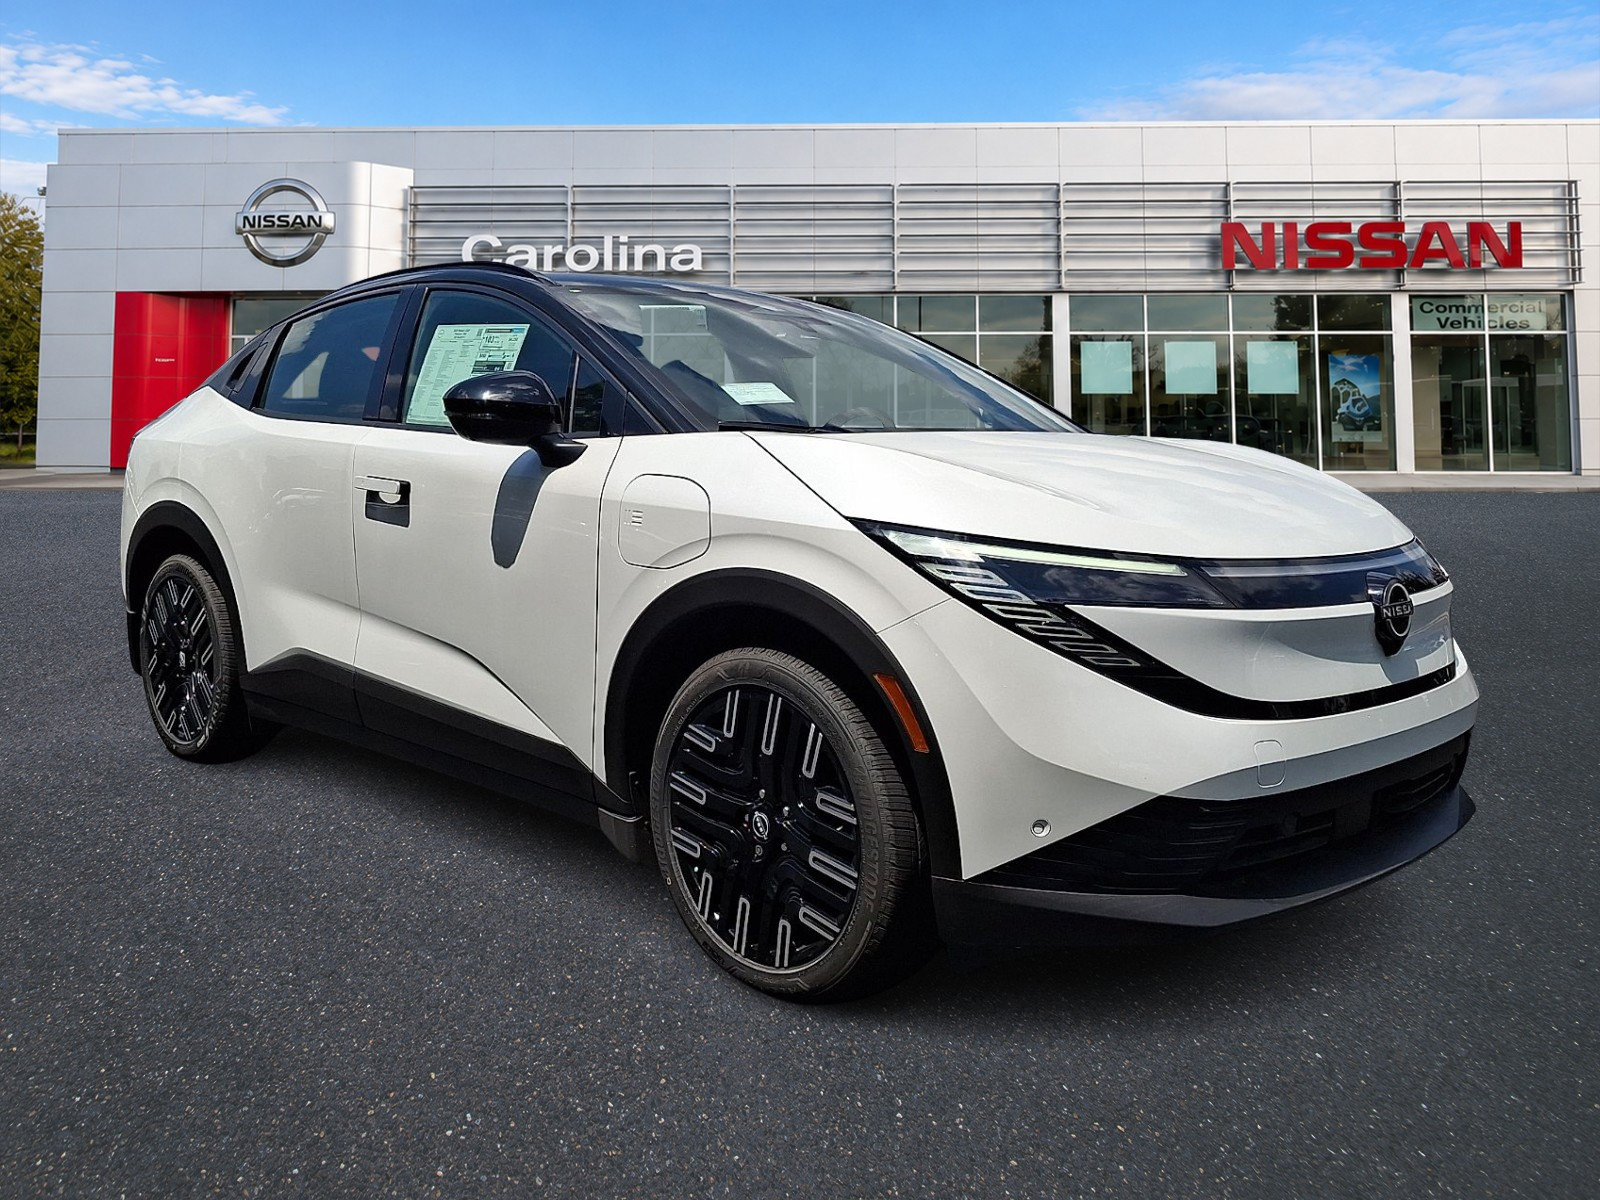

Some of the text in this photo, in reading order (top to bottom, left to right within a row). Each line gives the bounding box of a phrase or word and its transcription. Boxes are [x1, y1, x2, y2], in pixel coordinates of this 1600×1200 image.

[242, 214, 322, 229] NISSAN
[1220, 221, 1523, 270] NISSAN
[461, 234, 703, 272] Carolina
[1419, 300, 1543, 314] Commercial
[1436, 316, 1531, 330] Vehicles
[1382, 604, 1412, 618] NISS
